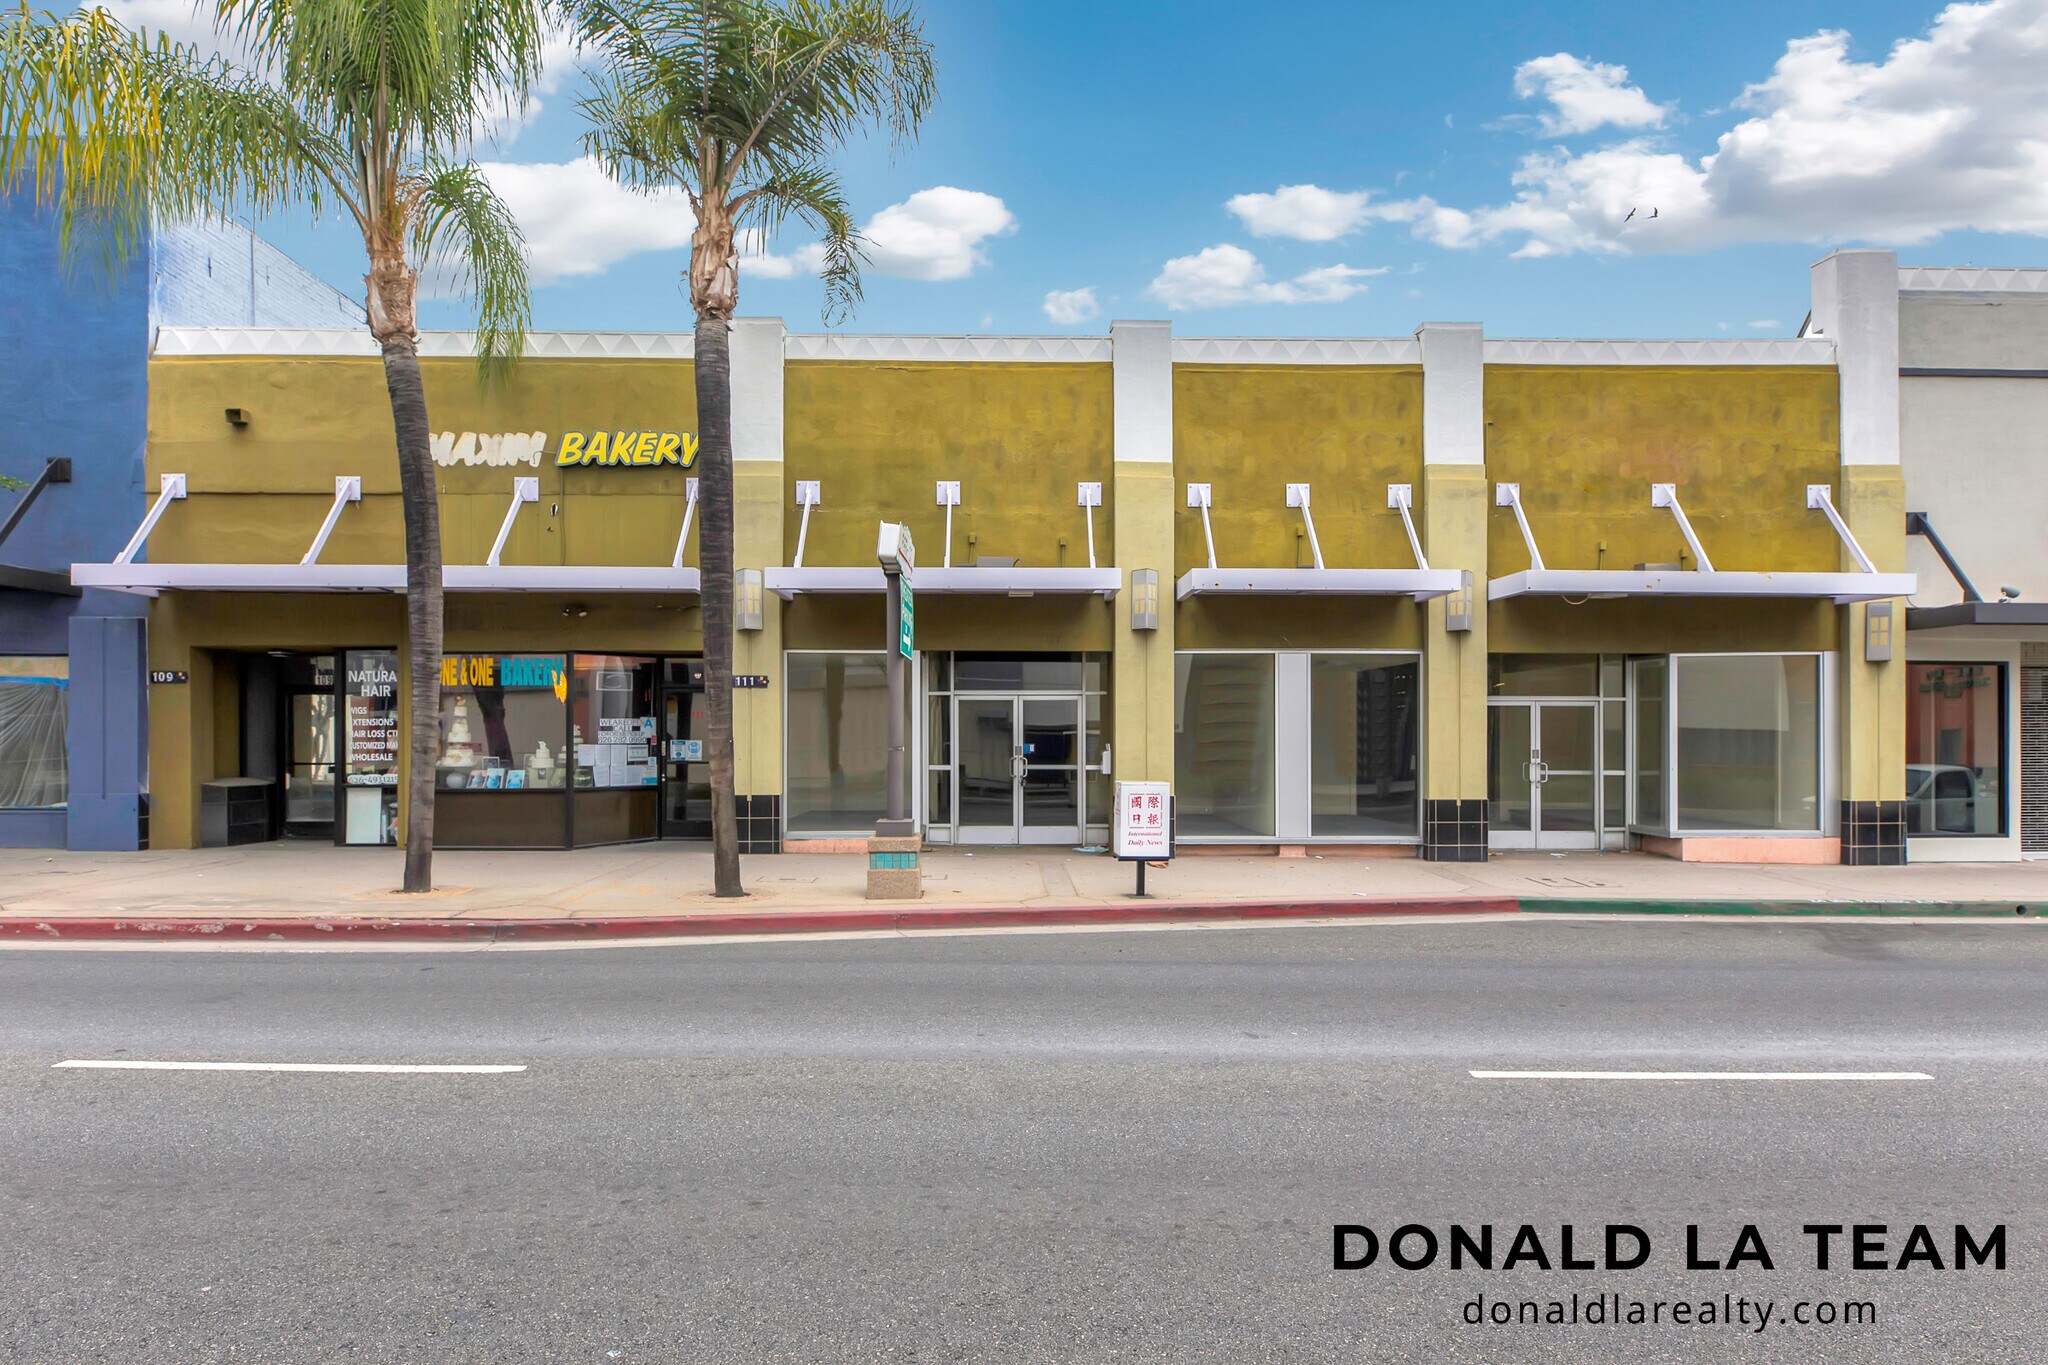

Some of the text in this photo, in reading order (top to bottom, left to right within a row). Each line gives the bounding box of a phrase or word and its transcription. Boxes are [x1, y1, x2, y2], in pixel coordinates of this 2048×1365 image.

[555, 430, 699, 469] BAKERY
[152, 672, 174, 682] 109
[439, 657, 564, 686] NE & ONE BAKERY
[317, 675, 331, 685] 109
[735, 676, 754, 686] 111
[361, 685, 391, 697] HAIR
[350, 718, 395, 726] XTENSIONS
[644, 718, 654, 729] A
[367, 730, 386, 738] LOSS
[1131, 796, 1160, 809] 國際
[1132, 813, 1159, 825] 日報
